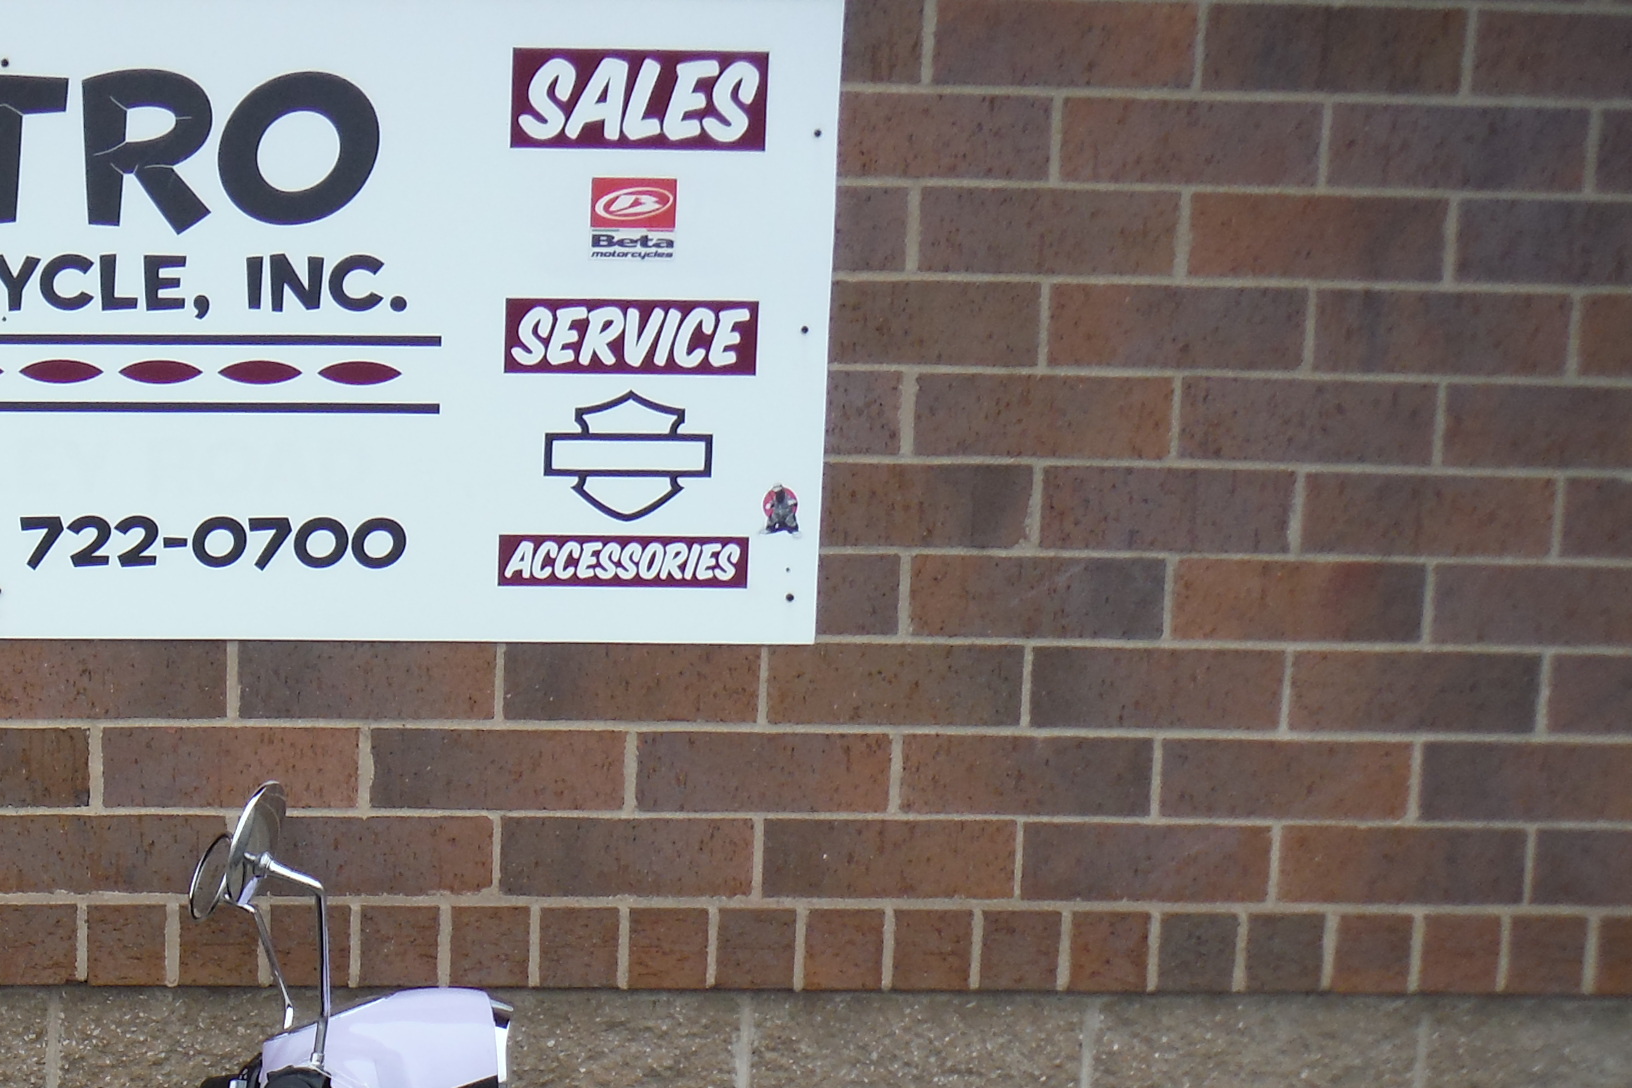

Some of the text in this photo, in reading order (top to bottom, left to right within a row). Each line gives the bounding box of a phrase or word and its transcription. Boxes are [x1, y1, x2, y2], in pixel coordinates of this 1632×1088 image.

[518, 57, 760, 143] SALES
[590, 250, 674, 260] motorcycles
[591, 234, 674, 249] Beta
[246, 253, 408, 313] INC.
[511, 306, 750, 368] SERVICE
[19, 515, 407, 571] 722-0700
[504, 540, 741, 581] ACCESSORIES
